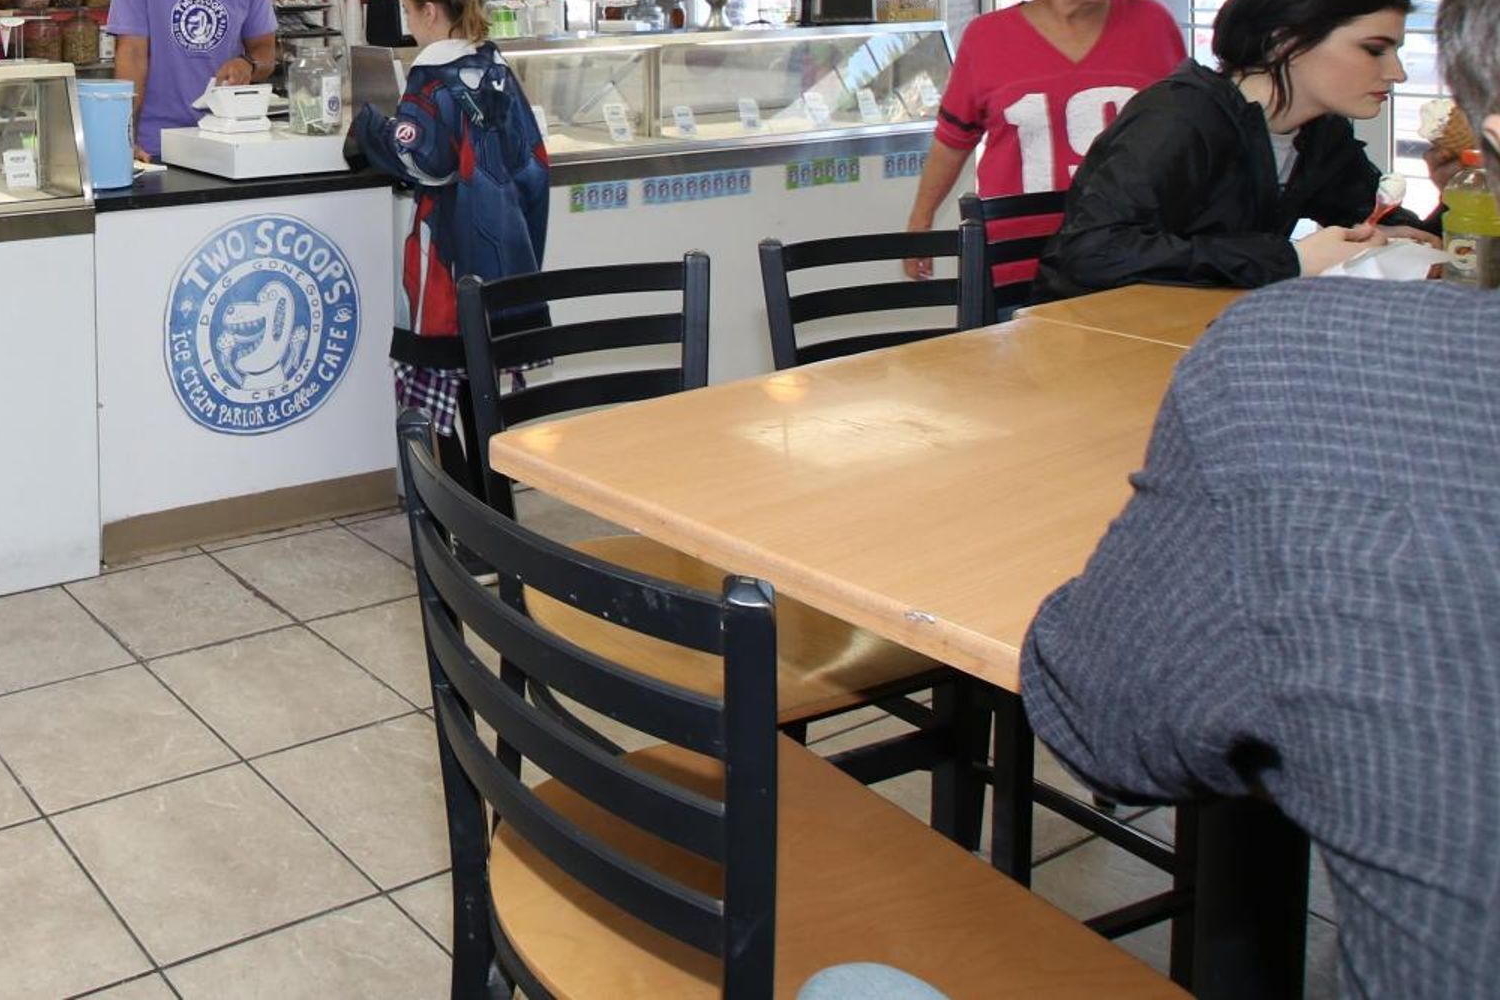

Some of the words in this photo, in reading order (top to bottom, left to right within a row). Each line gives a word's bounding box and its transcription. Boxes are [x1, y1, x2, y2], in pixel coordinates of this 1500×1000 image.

[182, 229, 246, 291] TWO
[255, 220, 351, 304] SCOOPS
[200, 276, 232, 326] DOG
[253, 259, 305, 281] GONE
[306, 283, 321, 333] GOOD
[203, 359, 232, 395] ICE
[217, 403, 265, 427] PARLOR
[267, 403, 281, 423] &
[281, 381, 320, 417] Coffee
[318, 327, 348, 381] CAFE
